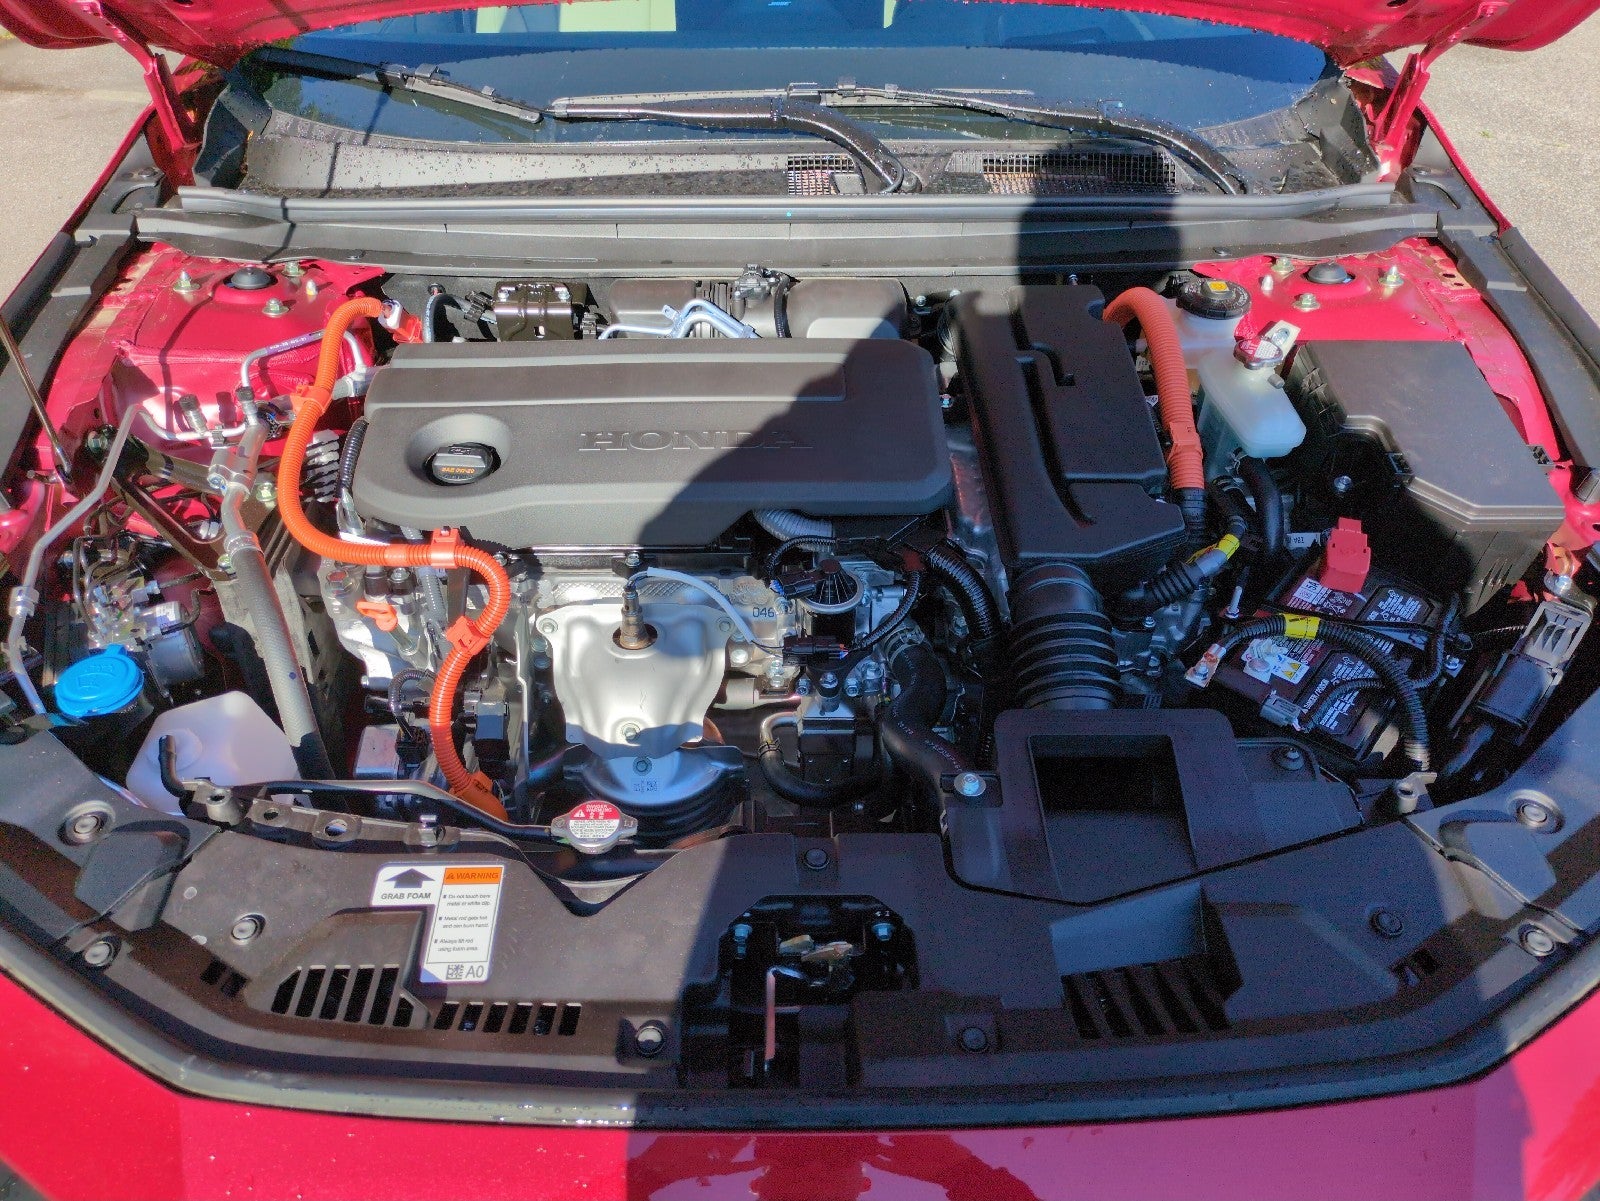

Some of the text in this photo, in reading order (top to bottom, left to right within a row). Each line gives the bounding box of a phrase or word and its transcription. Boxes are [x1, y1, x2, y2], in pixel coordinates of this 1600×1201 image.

[578, 430, 814, 451] HONDA
[752, 606, 775, 618] 046
[456, 872, 499, 880] WARNING
[380, 892, 432, 900] GRAB FOAM
[465, 965, 485, 978] A0
